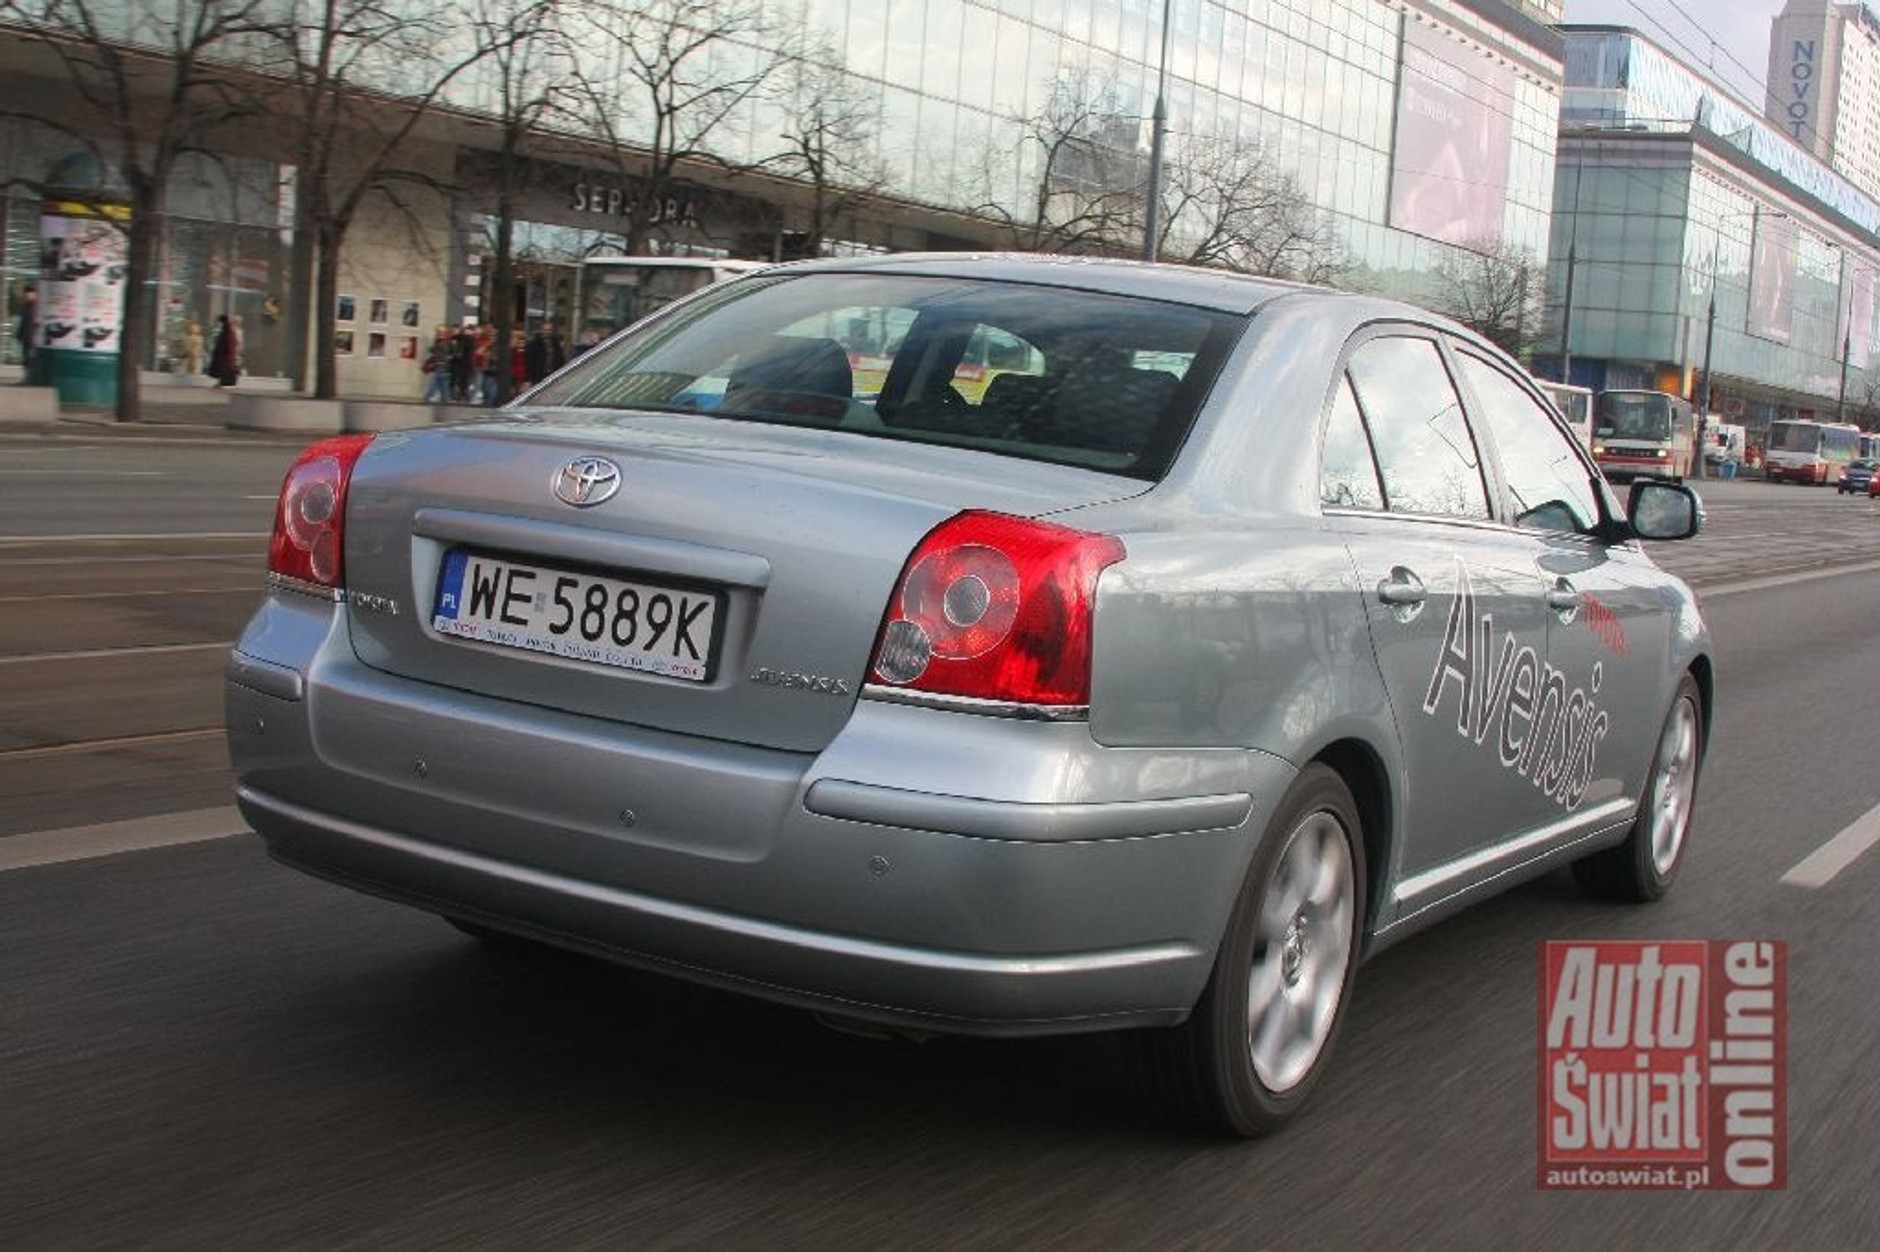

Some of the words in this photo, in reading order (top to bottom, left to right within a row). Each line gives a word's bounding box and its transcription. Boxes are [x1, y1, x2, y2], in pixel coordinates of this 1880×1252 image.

[469, 563, 536, 626] WE
[548, 576, 710, 660] 5889K
[1423, 553, 1608, 812] Avensis
